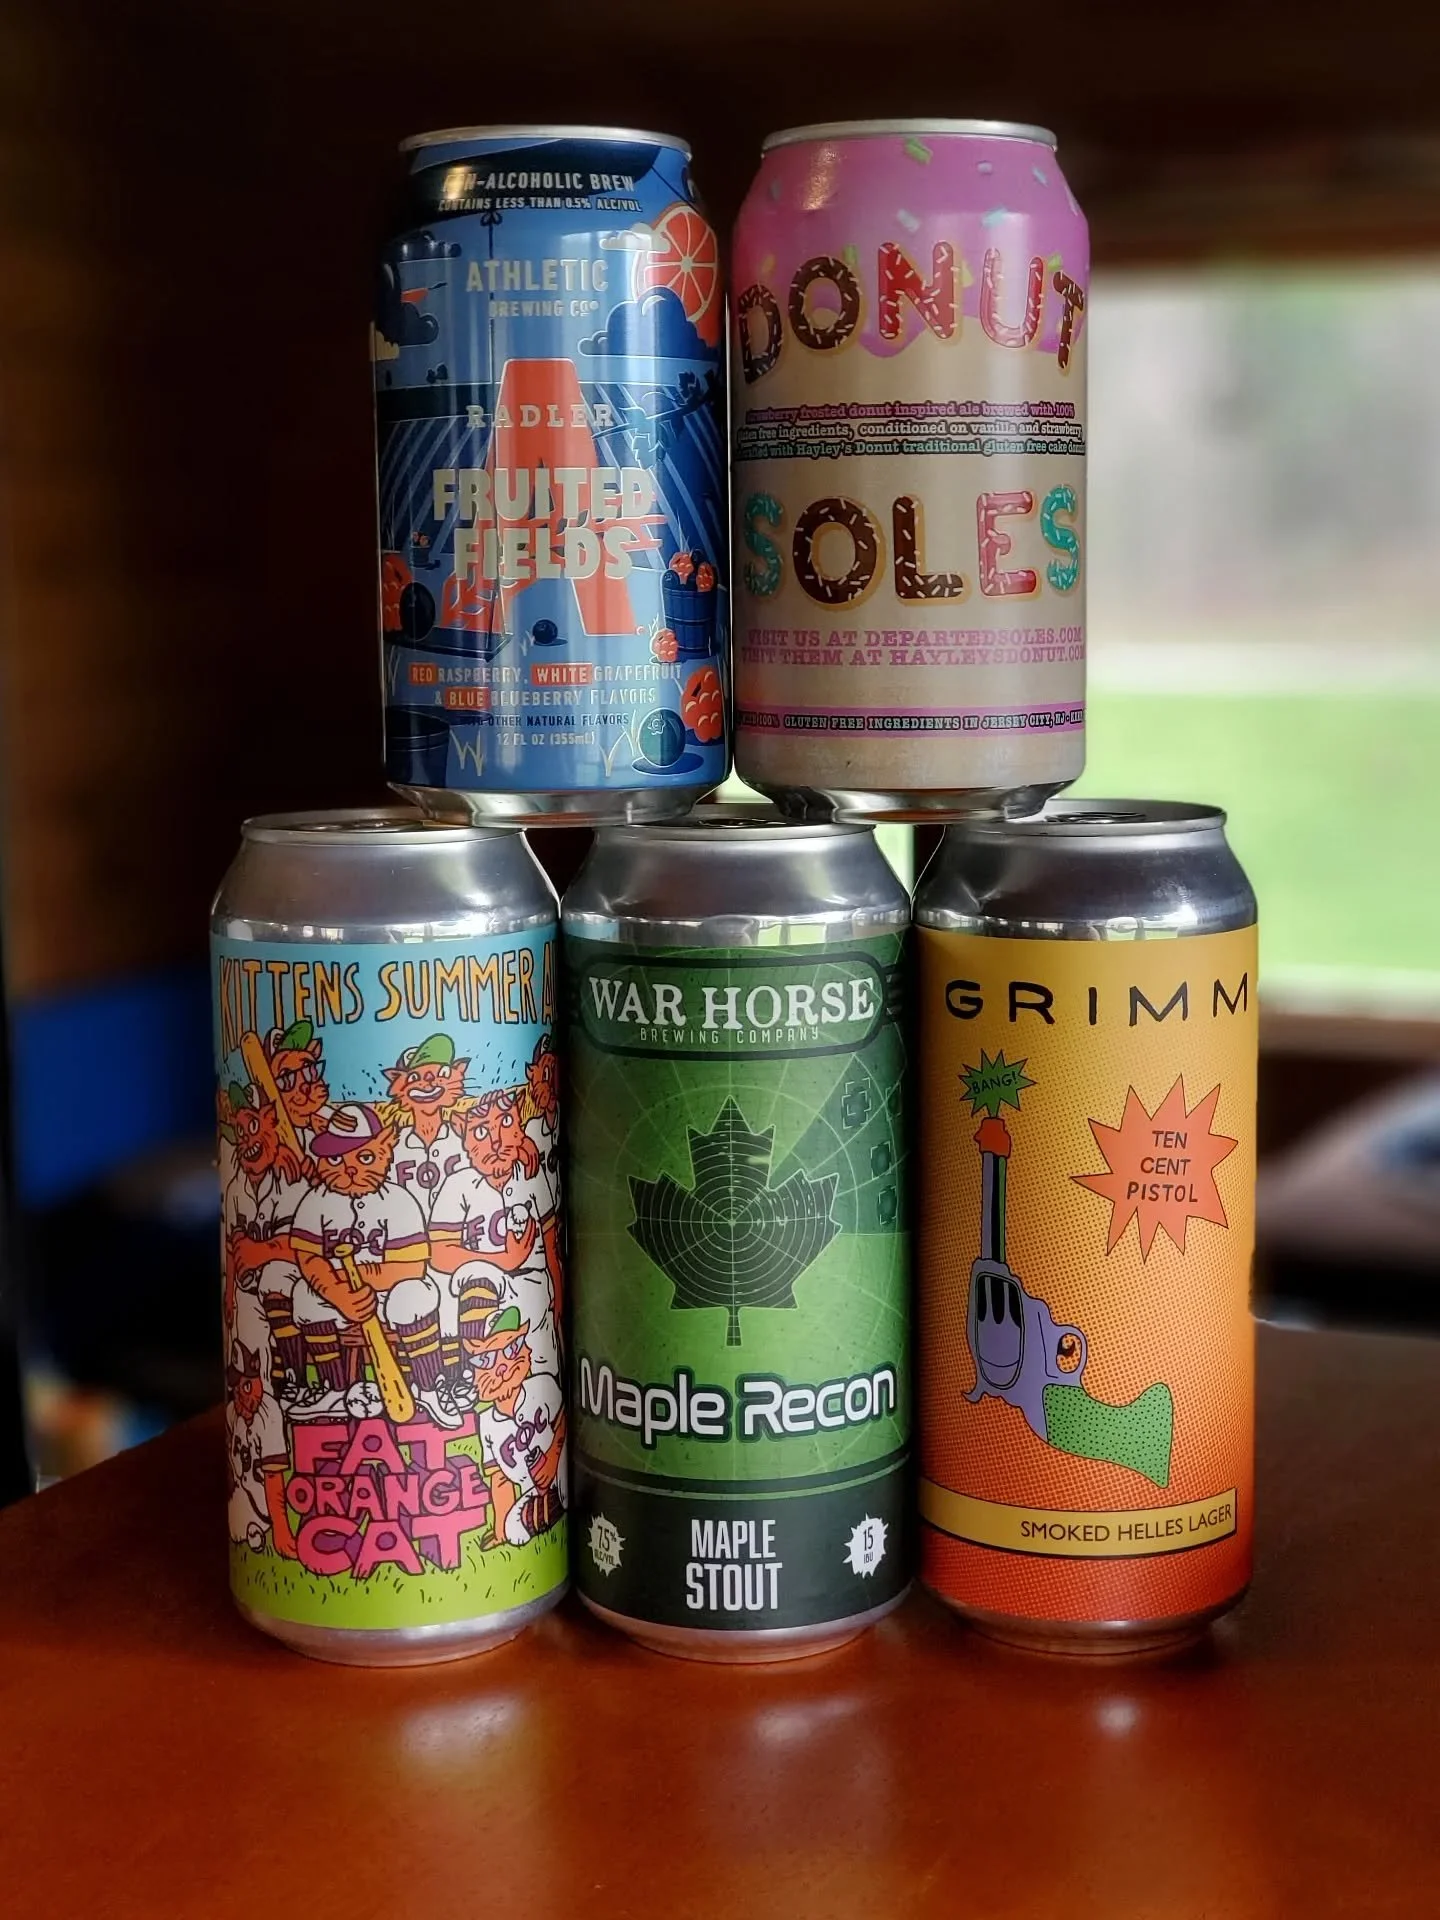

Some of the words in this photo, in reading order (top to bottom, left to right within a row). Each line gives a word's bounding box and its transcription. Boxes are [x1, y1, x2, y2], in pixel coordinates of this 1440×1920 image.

[589, 173, 635, 192] BREW
[438, 198, 491, 212] CONTAINS
[496, 197, 525, 209] LESS
[530, 197, 562, 209] THAN
[565, 197, 592, 209] 0.5%
[597, 198, 643, 212] ALC/VOL
[466, 258, 609, 292] ATHLETIC
[489, 300, 565, 317] BREWING
[738, 240, 1084, 385] DONUT
[466, 404, 615, 428] RADLER
[800, 404, 848, 419] frosted
[849, 402, 892, 417] donut
[894, 401, 956, 419] inspired
[959, 402, 980, 416] ale
[982, 402, 1029, 417] brewed
[1030, 402, 1054, 417] with
[1055, 403, 1075, 418] 100%
[758, 427, 777, 439] free
[778, 423, 853, 440] ingredients,
[859, 419, 947, 436] conditioned
[950, 422, 968, 435] on
[970, 419, 1018, 435] vanilla
[1018, 421, 1040, 436] and
[770, 443, 795, 457] with
[796, 440, 853, 459] Hayley's
[855, 441, 900, 455] Donut
[903, 438, 981, 455] traditional
[983, 439, 1025, 457] gluten
[1026, 439, 1047, 453] free
[1048, 440, 1068, 454] cake
[433, 467, 657, 521] FRUITED
[453, 526, 633, 580] FIELDS
[744, 484, 1080, 606] SOLES
[748, 629, 789, 645] VISIT
[795, 630, 820, 646] US
[827, 630, 858, 646] AT
[864, 626, 1082, 646] DEPARTEDSOLES.COM
[780, 649, 843, 665] THEM
[849, 649, 882, 665] AT
[412, 666, 433, 682] RED
[536, 666, 588, 683] WHITE
[594, 664, 681, 681] GRAPEFRUIT
[434, 690, 442, 705] &
[449, 692, 484, 707] BLUE
[490, 689, 583, 706] BLUEBERRY
[590, 688, 656, 704] FLAVORS
[488, 715, 522, 727] OTHER
[526, 715, 576, 727] NATURAL
[583, 714, 629, 727] FLAVORS
[784, 714, 828, 728] GLUTEN
[830, 716, 865, 730] FREE
[867, 716, 960, 730] INGREDIENTS
[963, 716, 979, 729] IN
[982, 714, 1028, 730] JERSEY
[1029, 713, 1054, 728] CITY,
[1055, 711, 1065, 725] NJ
[497, 733, 510, 747] 12
[513, 733, 527, 746] FL
[531, 733, 545, 746] OZ
[219, 954, 364, 1062] KITTENS
[375, 948, 537, 1024] SUMMER
[589, 977, 687, 1026] WAR
[701, 977, 875, 1031] HORSE
[945, 972, 1248, 1027] GRIMM
[640, 1027, 720, 1044] BREWING
[737, 1025, 819, 1044] COMPANY
[972, 1072, 1018, 1094] BANG!
[1152, 1130, 1188, 1149] TEN
[1140, 1157, 1192, 1176] CENT
[1126, 1181, 1199, 1203] PISTOL
[580, 1357, 726, 1445] Maple
[743, 1369, 895, 1436] Recon
[292, 1411, 478, 1477] FAT
[500, 1406, 550, 1468] FOC
[286, 1464, 492, 1521] ORANGE
[1020, 1521, 1110, 1542] SMOKED
[1117, 1517, 1184, 1541] HELLES
[1188, 1503, 1232, 1530] LAGER
[296, 1509, 486, 1580] CAT
[691, 1519, 776, 1559] MAPLE
[862, 1527, 874, 1551] 15
[863, 1551, 874, 1564] IBU
[686, 1562, 783, 1612] STOUT
